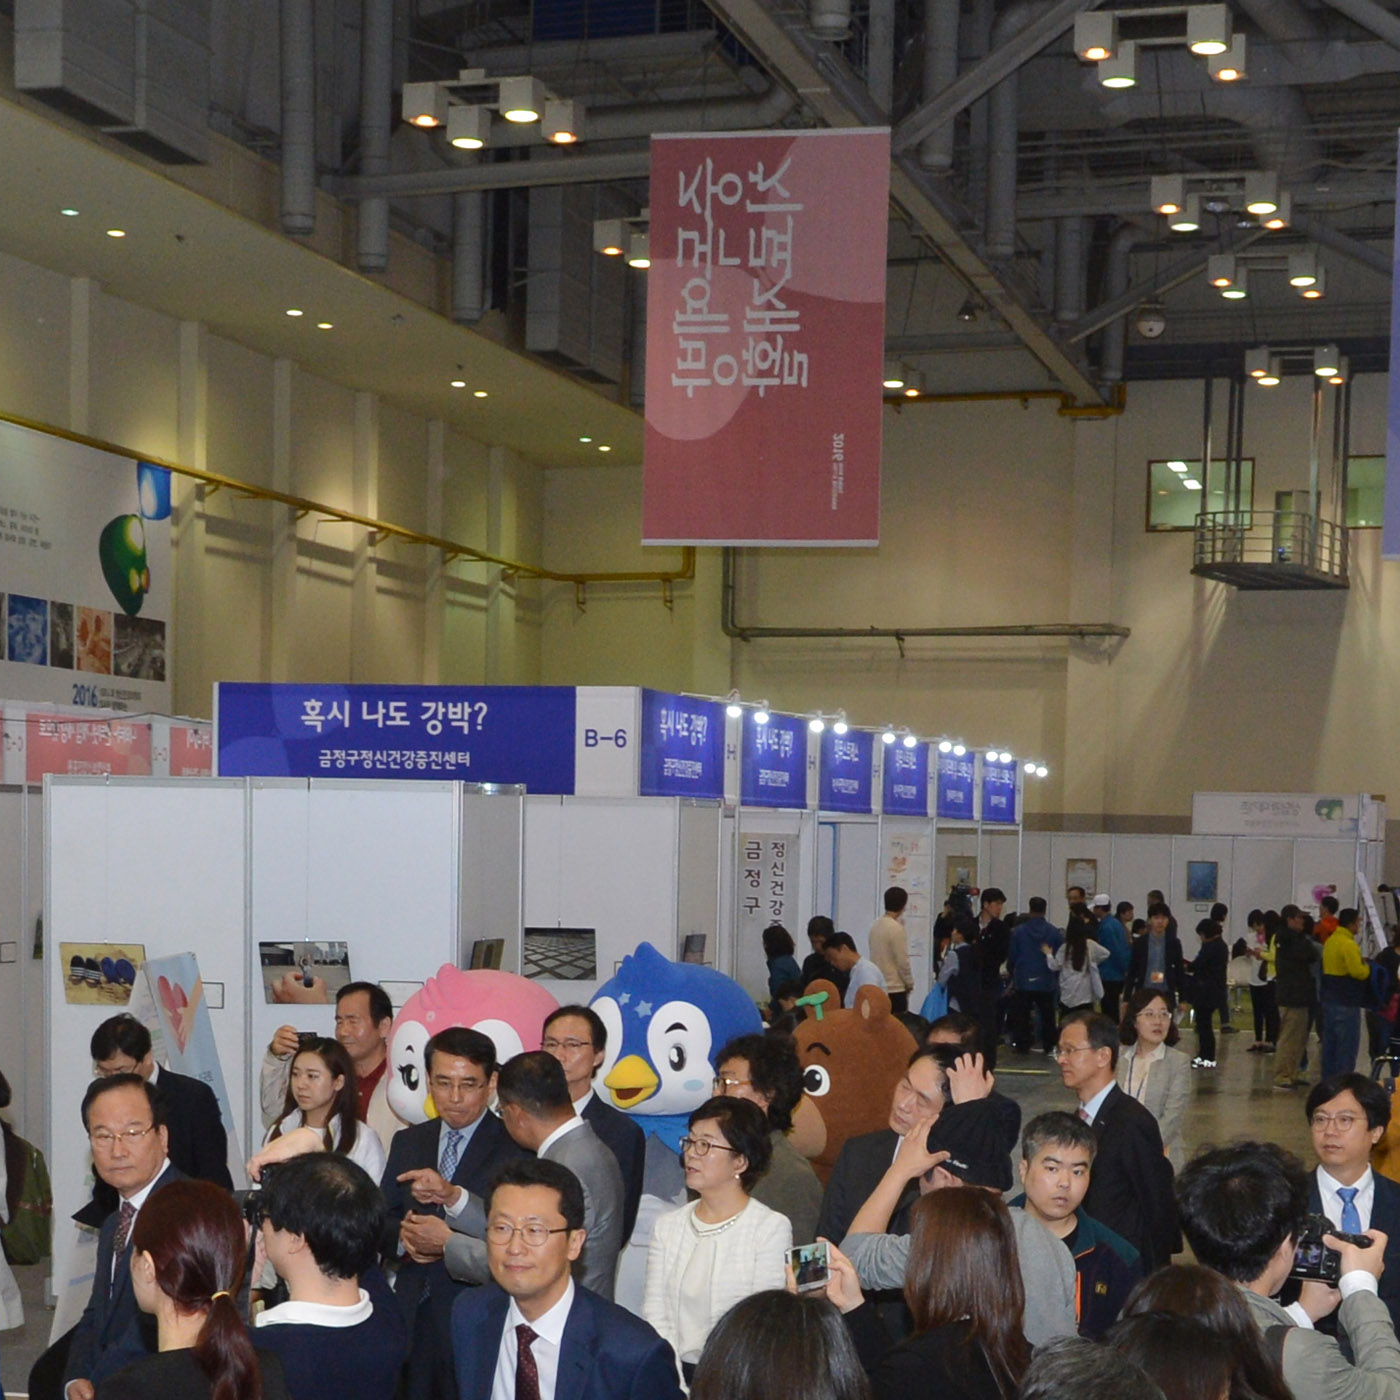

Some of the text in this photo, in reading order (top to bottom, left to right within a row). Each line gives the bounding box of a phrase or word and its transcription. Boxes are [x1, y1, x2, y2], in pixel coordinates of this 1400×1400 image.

[300, 699, 488, 735] 혹시 나도 강박?
[584, 728, 627, 748] B-6
[318, 749, 471, 770] 금정구정신건강증진센터
